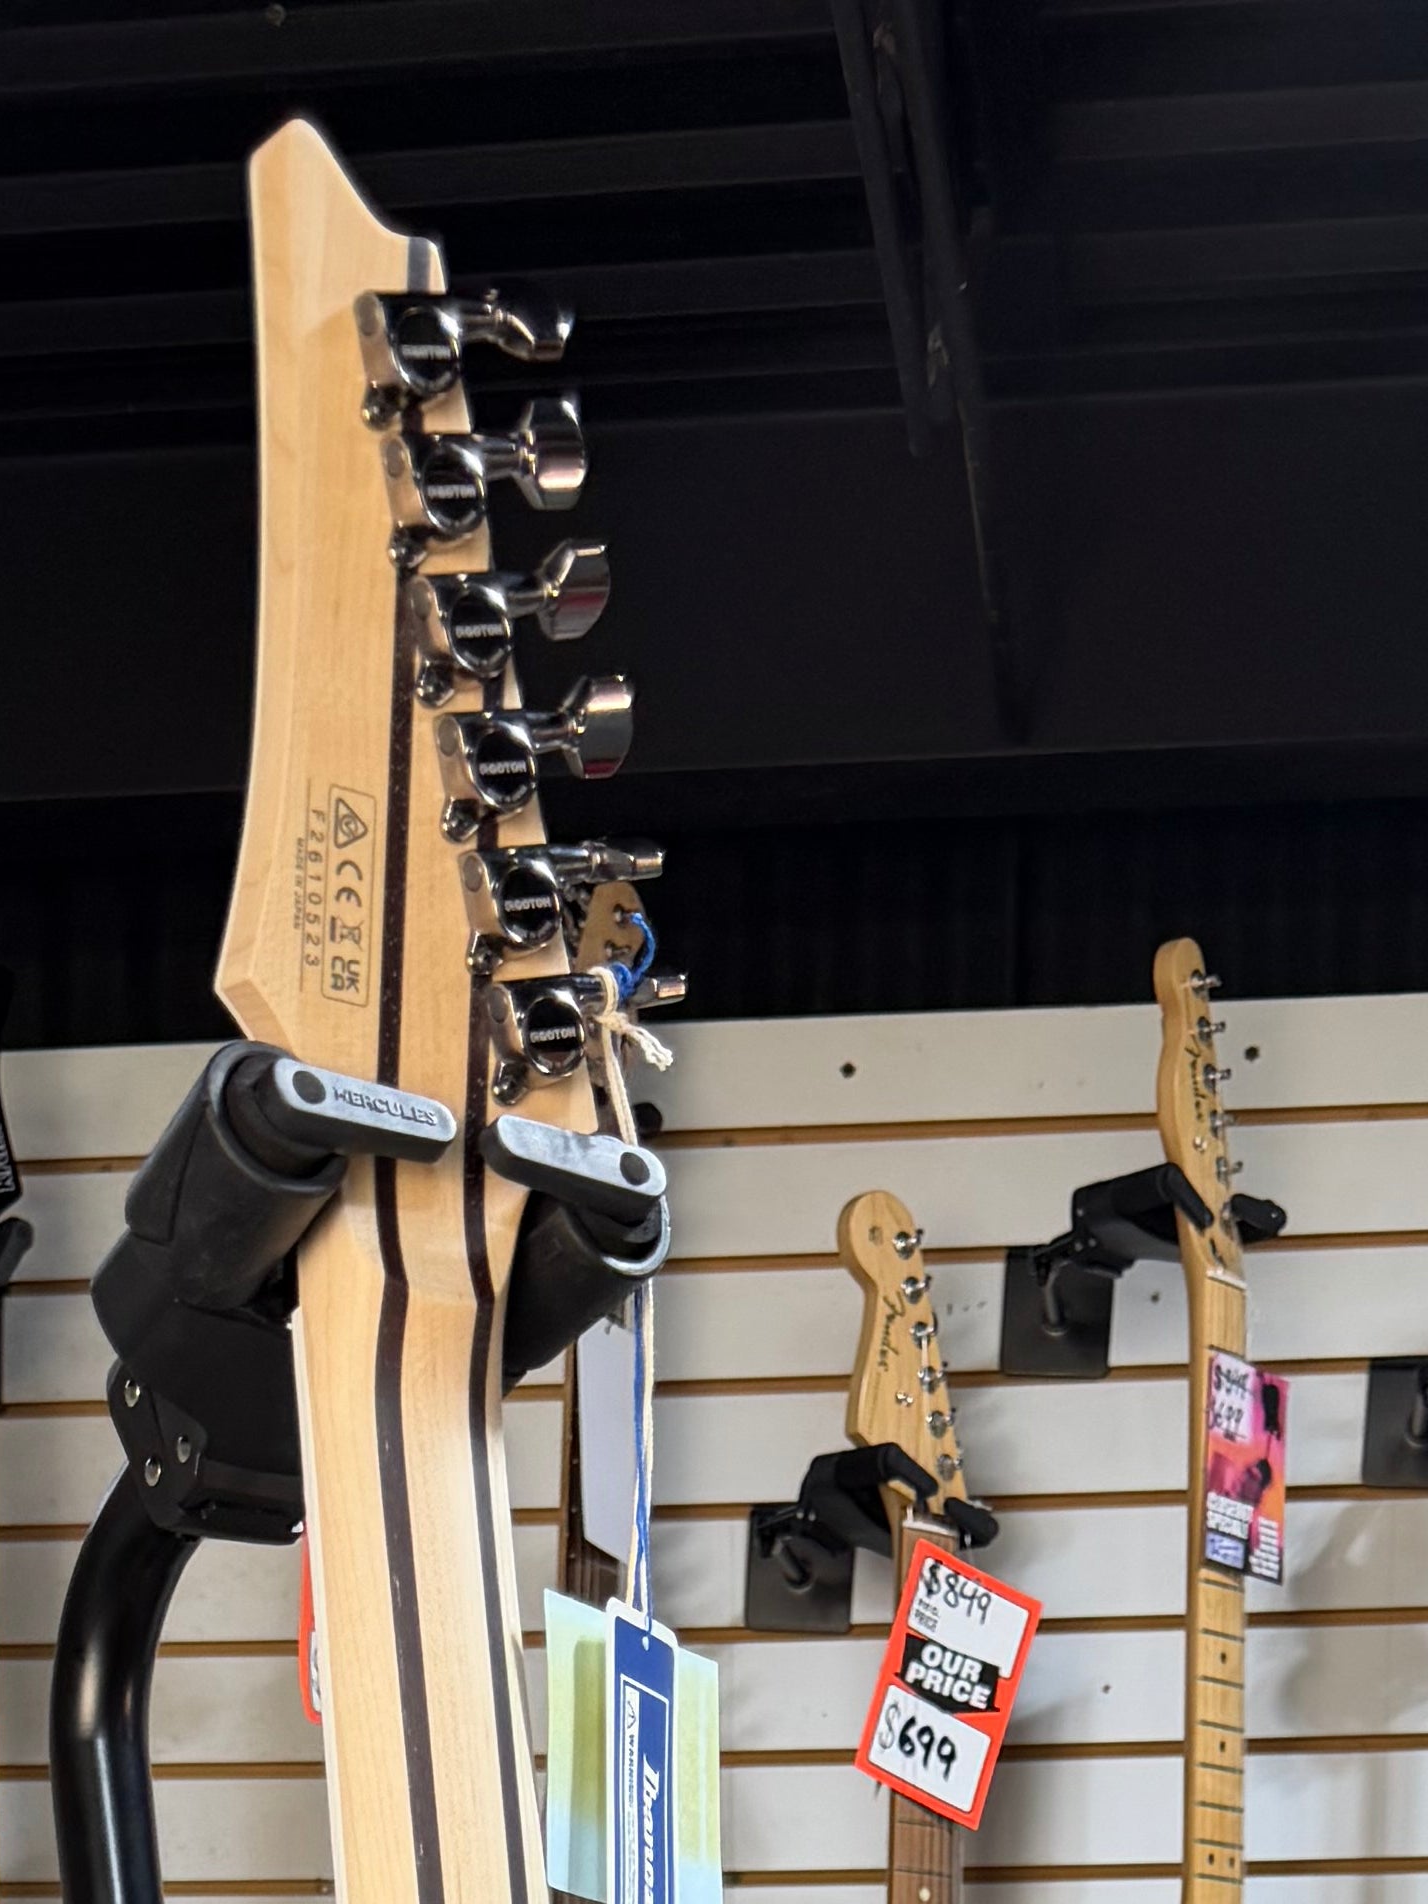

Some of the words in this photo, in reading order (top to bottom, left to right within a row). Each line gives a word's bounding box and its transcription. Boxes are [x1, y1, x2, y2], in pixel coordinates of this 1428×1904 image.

[304, 809, 326, 967] F2610523
[332, 1084, 437, 1127] HERCULES
[922, 1559, 993, 1625] $849
[905, 1661, 993, 1710] PRICE
[920, 1644, 983, 1684] OUR
[877, 1700, 958, 1782] $699
